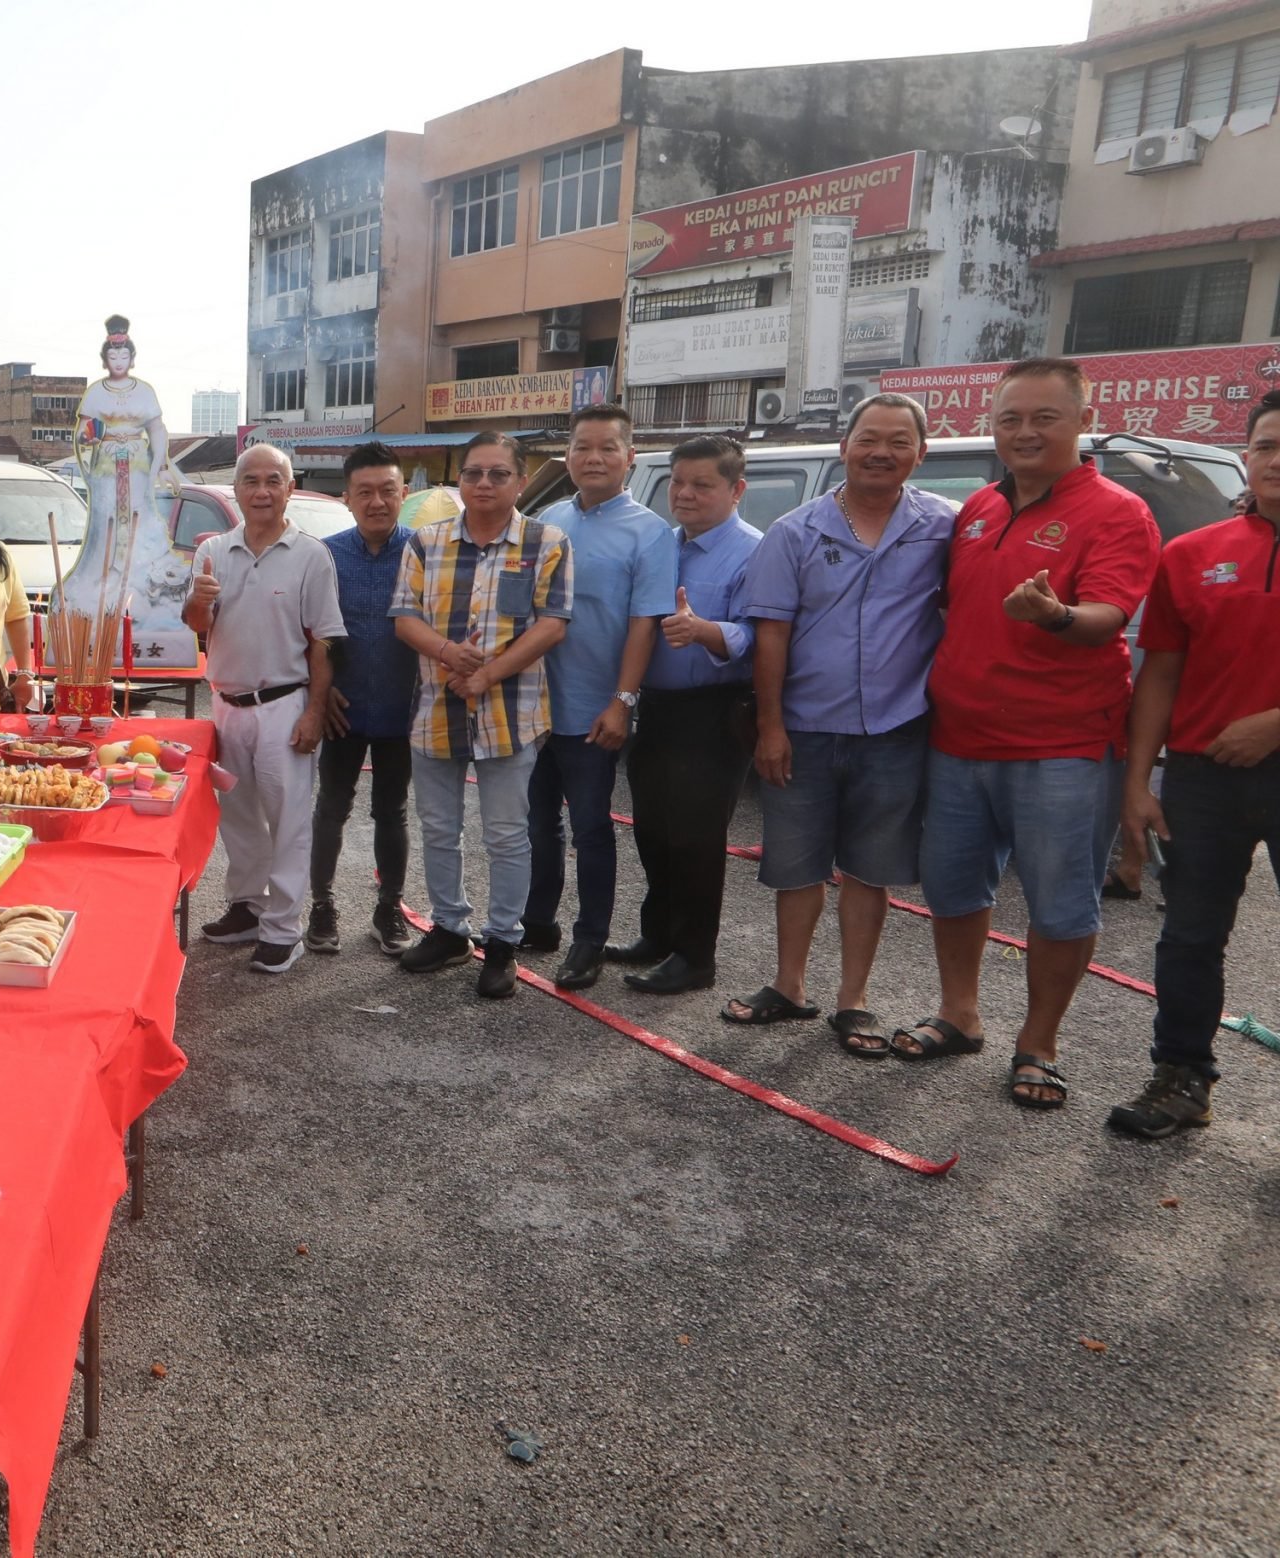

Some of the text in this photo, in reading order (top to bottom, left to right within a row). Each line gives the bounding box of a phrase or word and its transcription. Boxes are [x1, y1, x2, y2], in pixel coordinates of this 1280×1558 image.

[684, 166, 902, 227] KEDAI UBAT DAN RUNCIT
[709, 218, 741, 238] EKA
[745, 208, 782, 231] MINI
[787, 193, 864, 222] MARKET
[632, 234, 665, 251] Panadol
[828, 274, 841, 284] MINI
[815, 285, 839, 295] MARKET
[692, 324, 721, 338] KEDAI
[724, 318, 752, 333] UBAT
[754, 316, 774, 330] DAN
[692, 338, 716, 352] EKA
[722, 335, 752, 349] MINI
[454, 382, 475, 400] KEDAI
[477, 379, 517, 397] BARANGAN
[518, 372, 570, 394] SEMBAHYANG
[882, 377, 910, 389] KEDAI
[912, 374, 966, 388] BARANGAN
[1226, 385, 1251, 399] 旺
[454, 399, 482, 414] CHEAN
[484, 397, 507, 412] FATT
[266, 423, 363, 439] PEMBEKAL BARANGAN PERSOLEKAN
